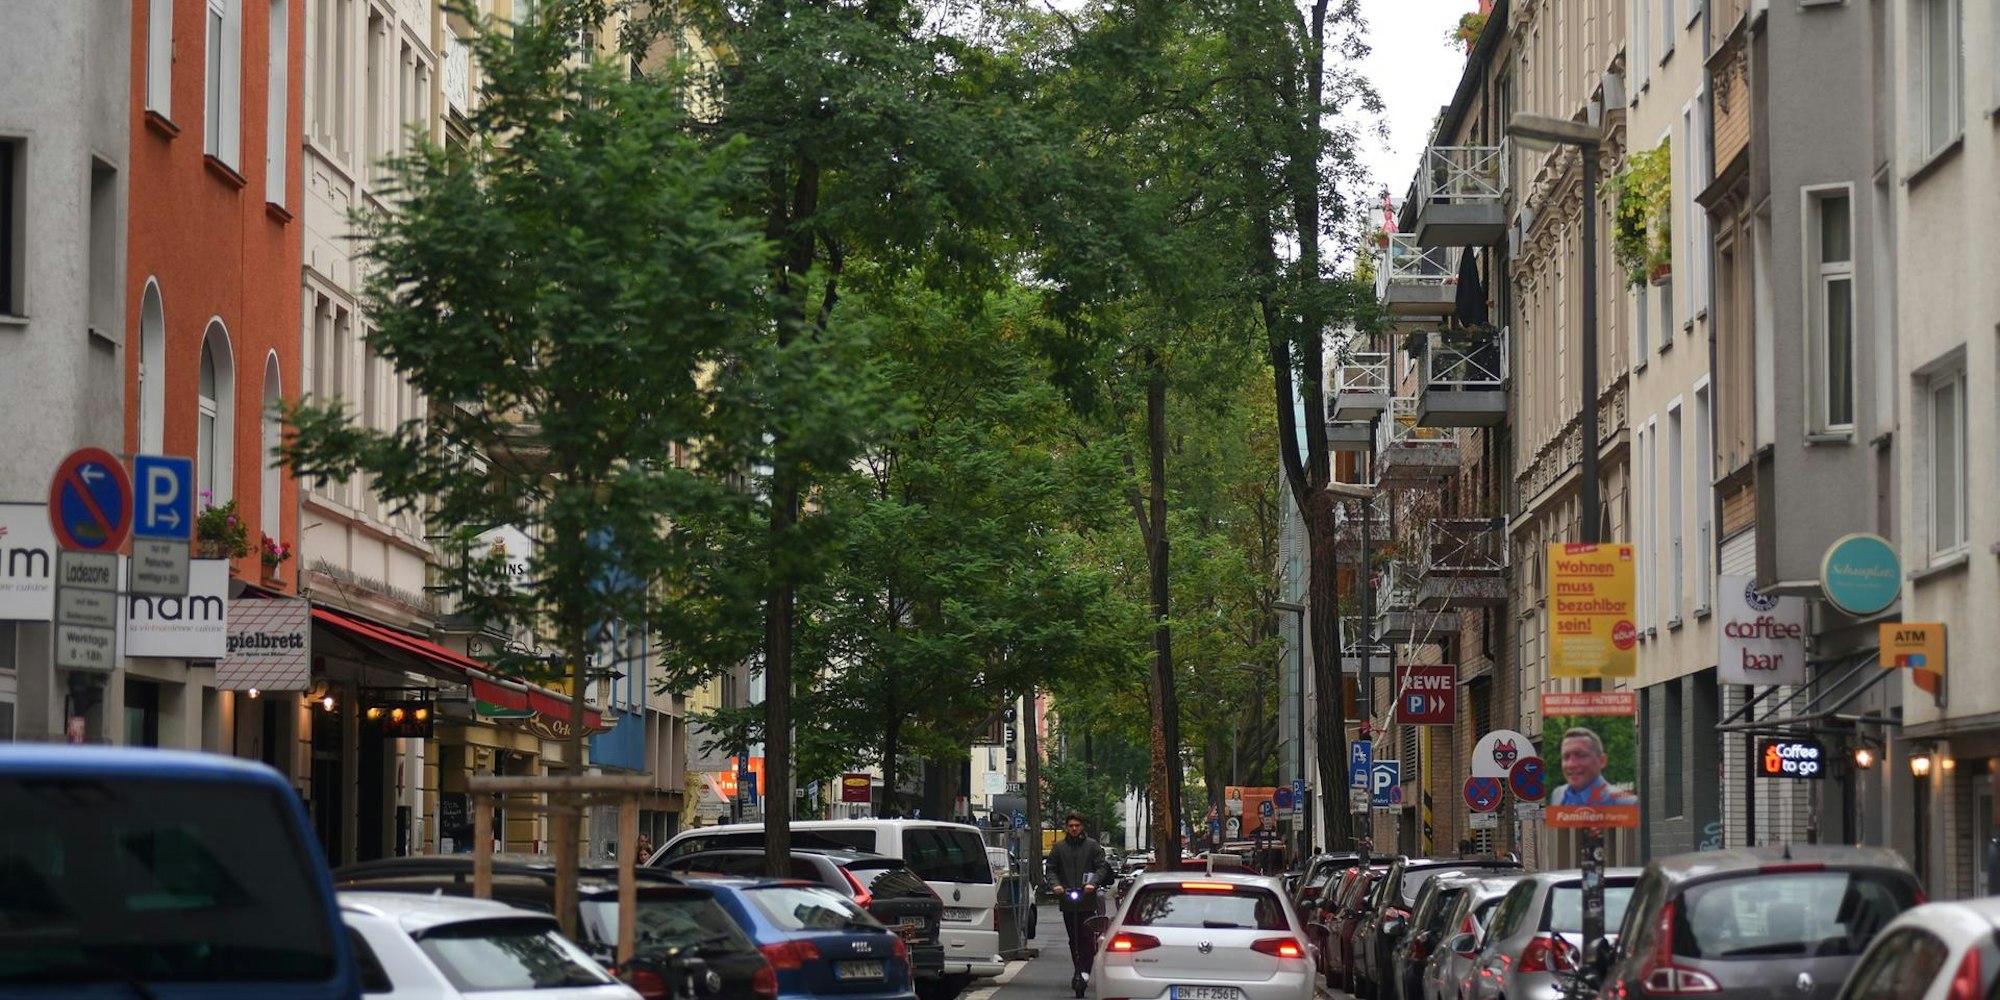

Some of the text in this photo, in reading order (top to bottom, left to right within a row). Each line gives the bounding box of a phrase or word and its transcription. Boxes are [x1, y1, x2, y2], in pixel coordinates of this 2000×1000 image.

[147, 467, 178, 527] P
[0, 548, 49, 578] m
[1556, 561, 1615, 573] Wohnen
[66, 562, 109, 584] Ladezone
[1557, 582, 1594, 593] muss
[130, 595, 223, 621] nam
[1557, 599, 1626, 612] bezahlbar
[1557, 618, 1591, 631] sein!
[1725, 616, 1801, 640] coffee
[66, 632, 108, 648] Werktags
[226, 631, 304, 653] pielbrett
[1895, 631, 1926, 641] ATM
[1743, 647, 1783, 671] bar
[1401, 675, 1451, 690] REWE
[1410, 697, 1422, 713] P
[1776, 743, 1819, 758] Coffee
[1782, 759, 1818, 775] to go
[1005, 783, 1021, 792] OTEL
[1374, 772, 1392, 795] P
[1556, 811, 1604, 822] Familien
[1177, 987, 1194, 999] BN
[1197, 988, 1209, 1000] FF
